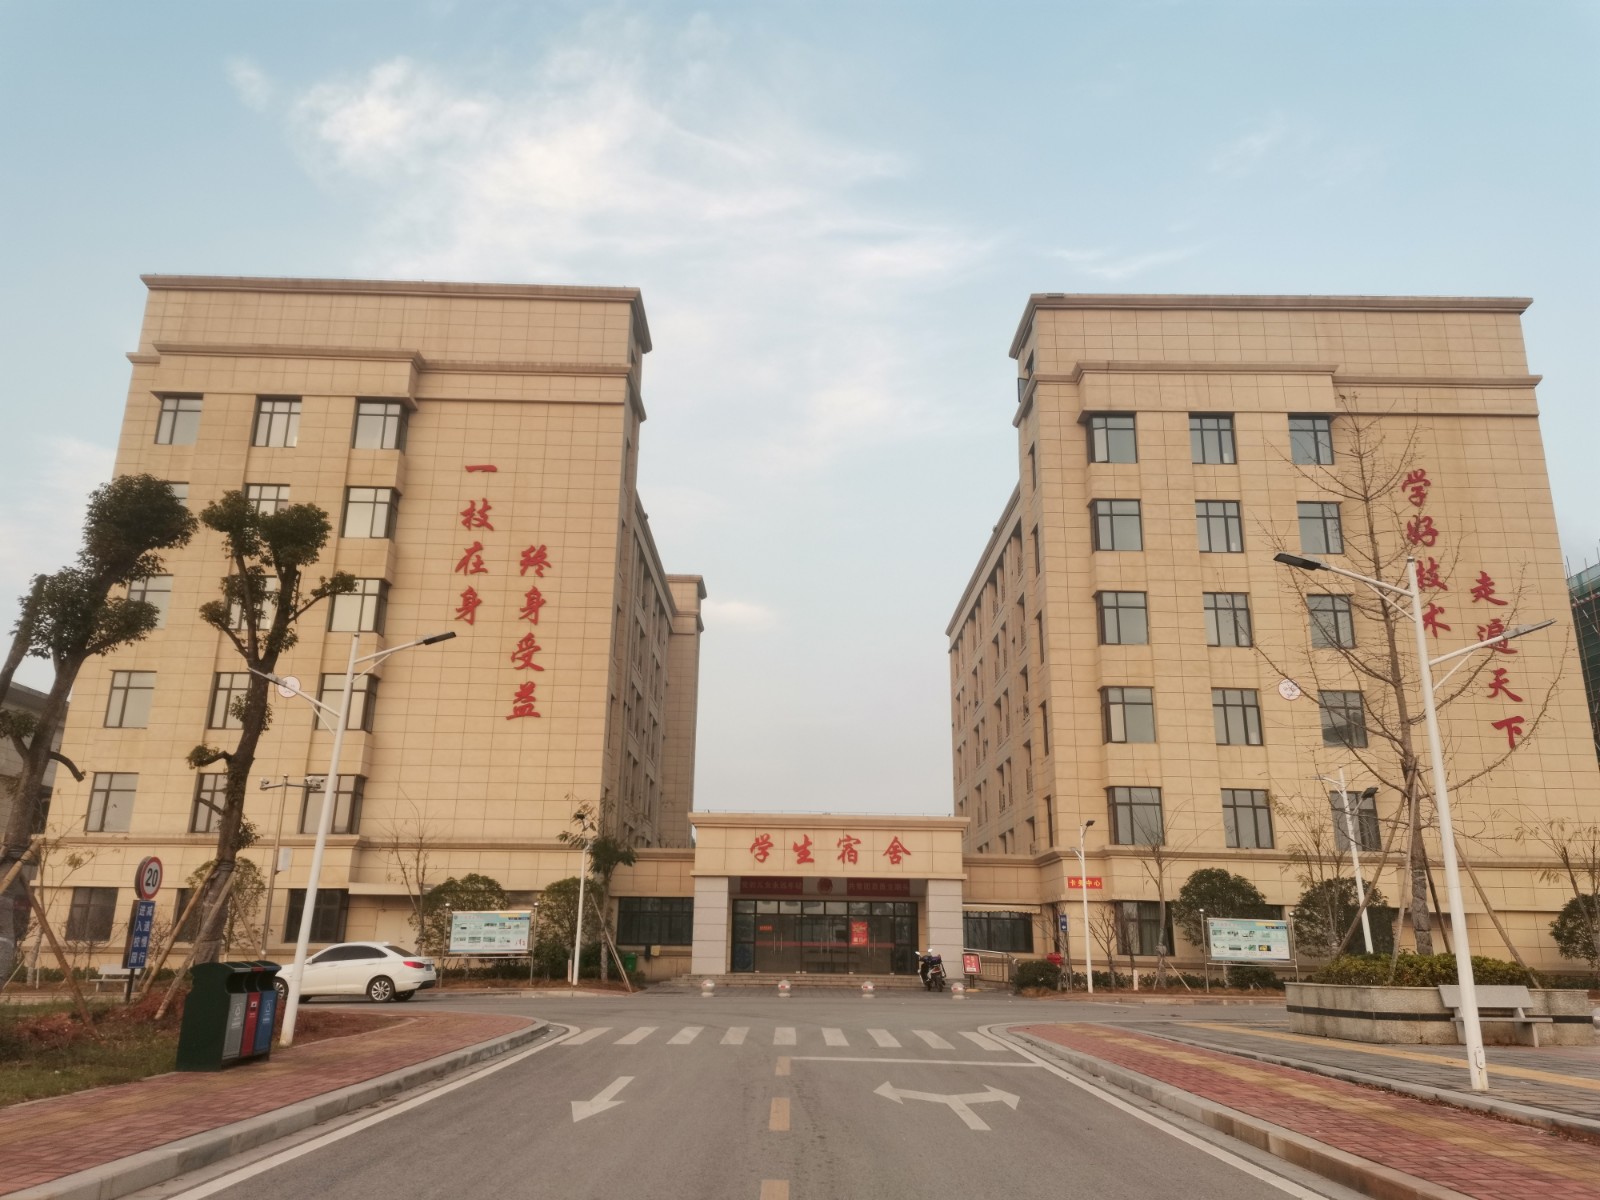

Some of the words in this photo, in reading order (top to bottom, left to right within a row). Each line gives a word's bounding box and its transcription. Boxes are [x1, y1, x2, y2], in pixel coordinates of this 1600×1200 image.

[454, 464, 498, 626] 一技在身
[1401, 468, 1451, 639] 学好技术
[506, 544, 552, 721] 终身受益
[1470, 570, 1525, 750] 走遍天下
[145, 867, 158, 887] 20
[750, 833, 911, 865] 学生宿舍
